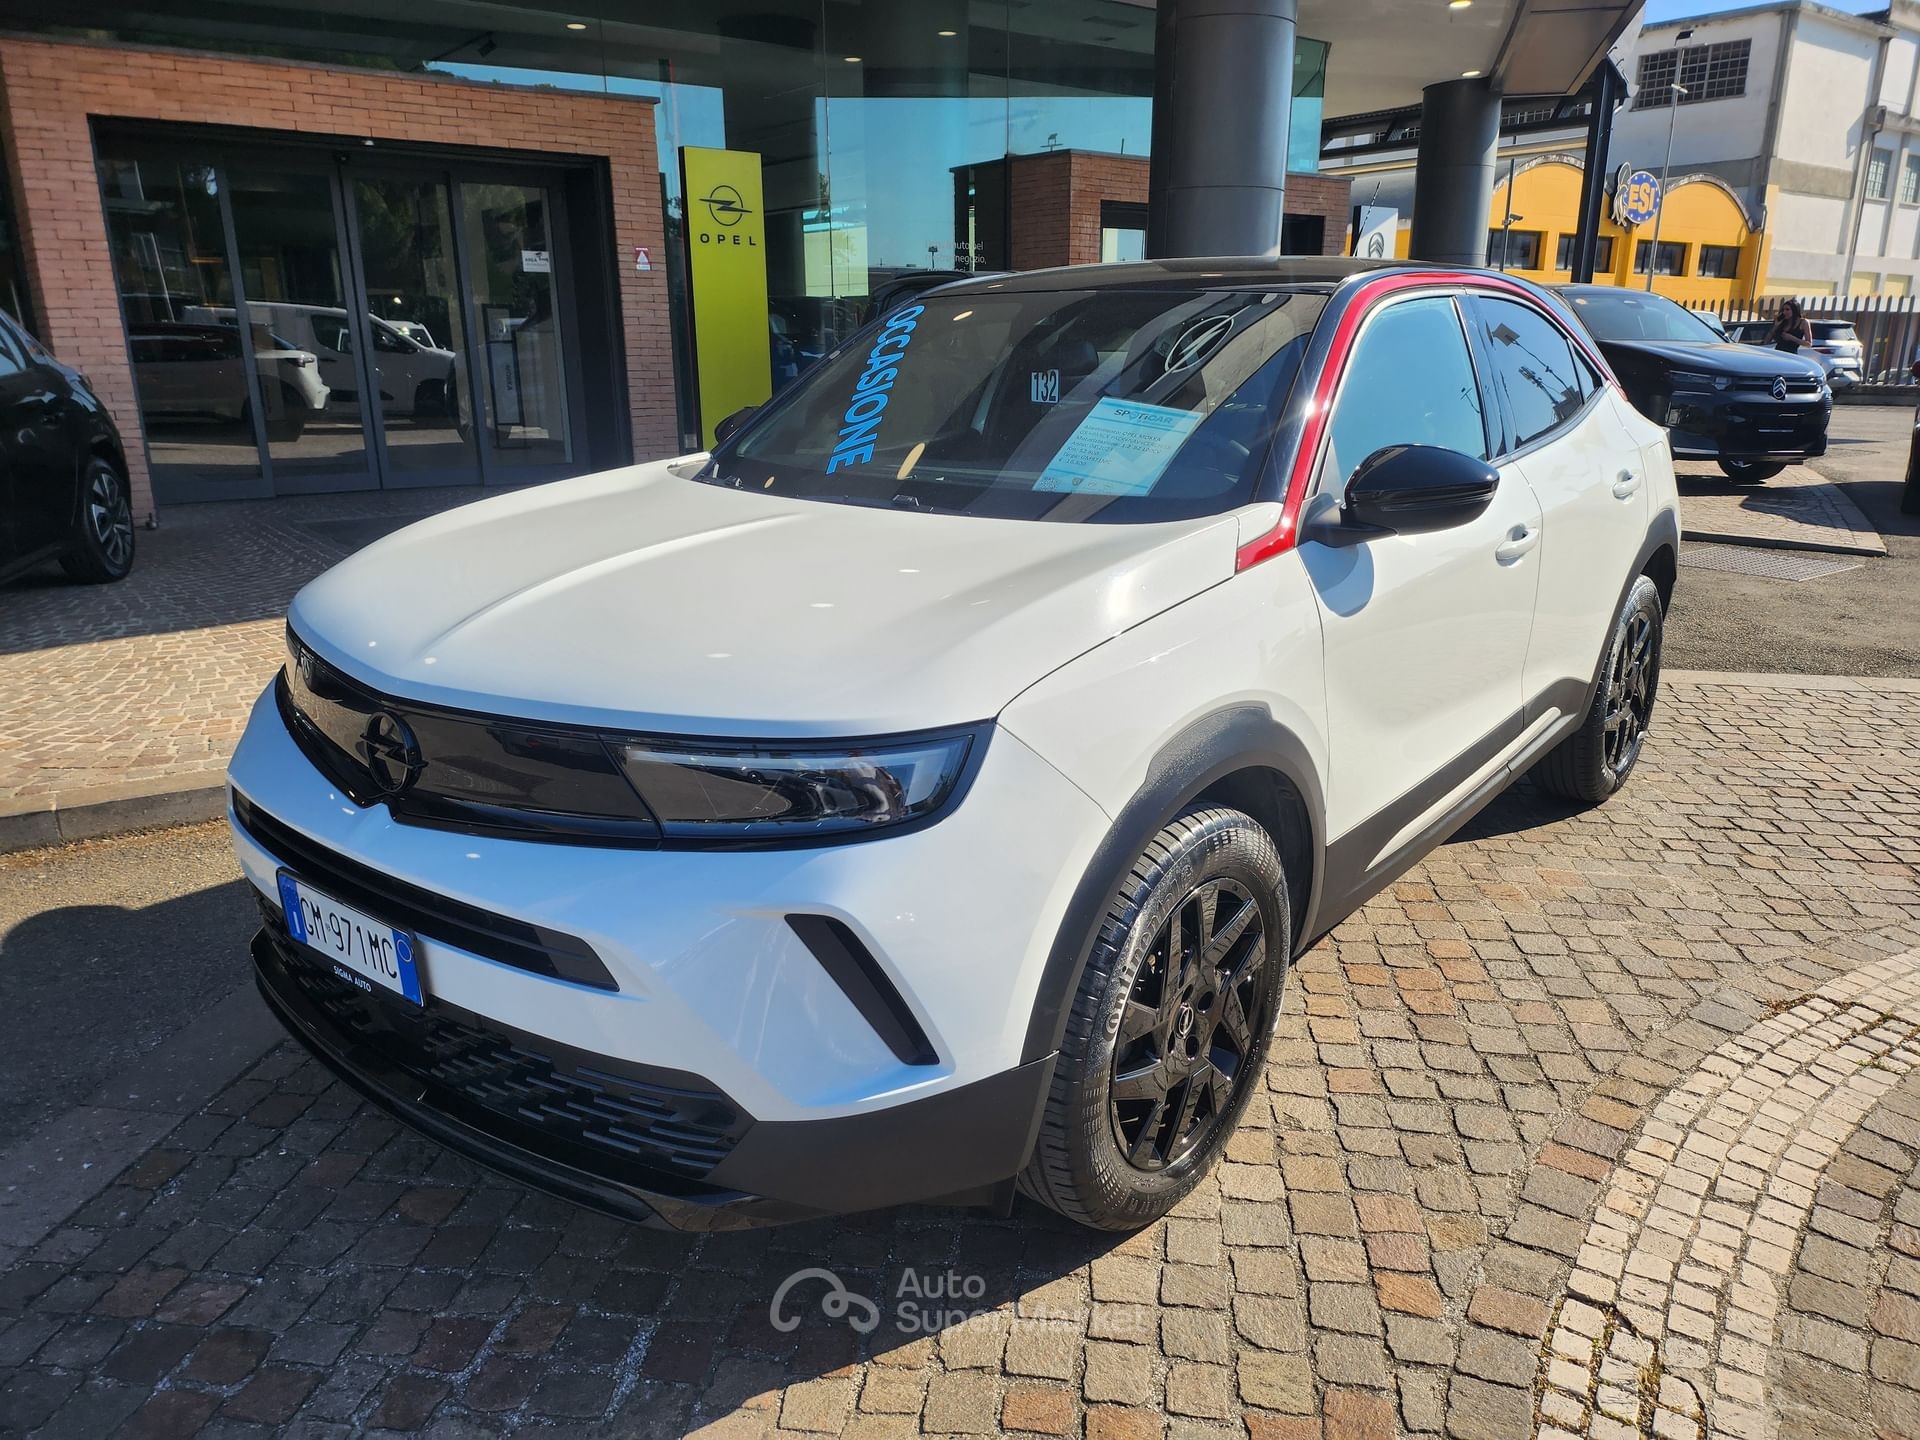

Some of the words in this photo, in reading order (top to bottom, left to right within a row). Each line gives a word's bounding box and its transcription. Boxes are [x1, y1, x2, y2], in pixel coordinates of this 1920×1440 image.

[1628, 182, 1656, 214] ESI
[700, 233, 757, 246] OPEL
[826, 304, 926, 475] OCCASIONE
[1033, 370, 1057, 402] 132
[333, 965, 353, 983] SIGMA
[354, 976, 372, 993] AUTO
